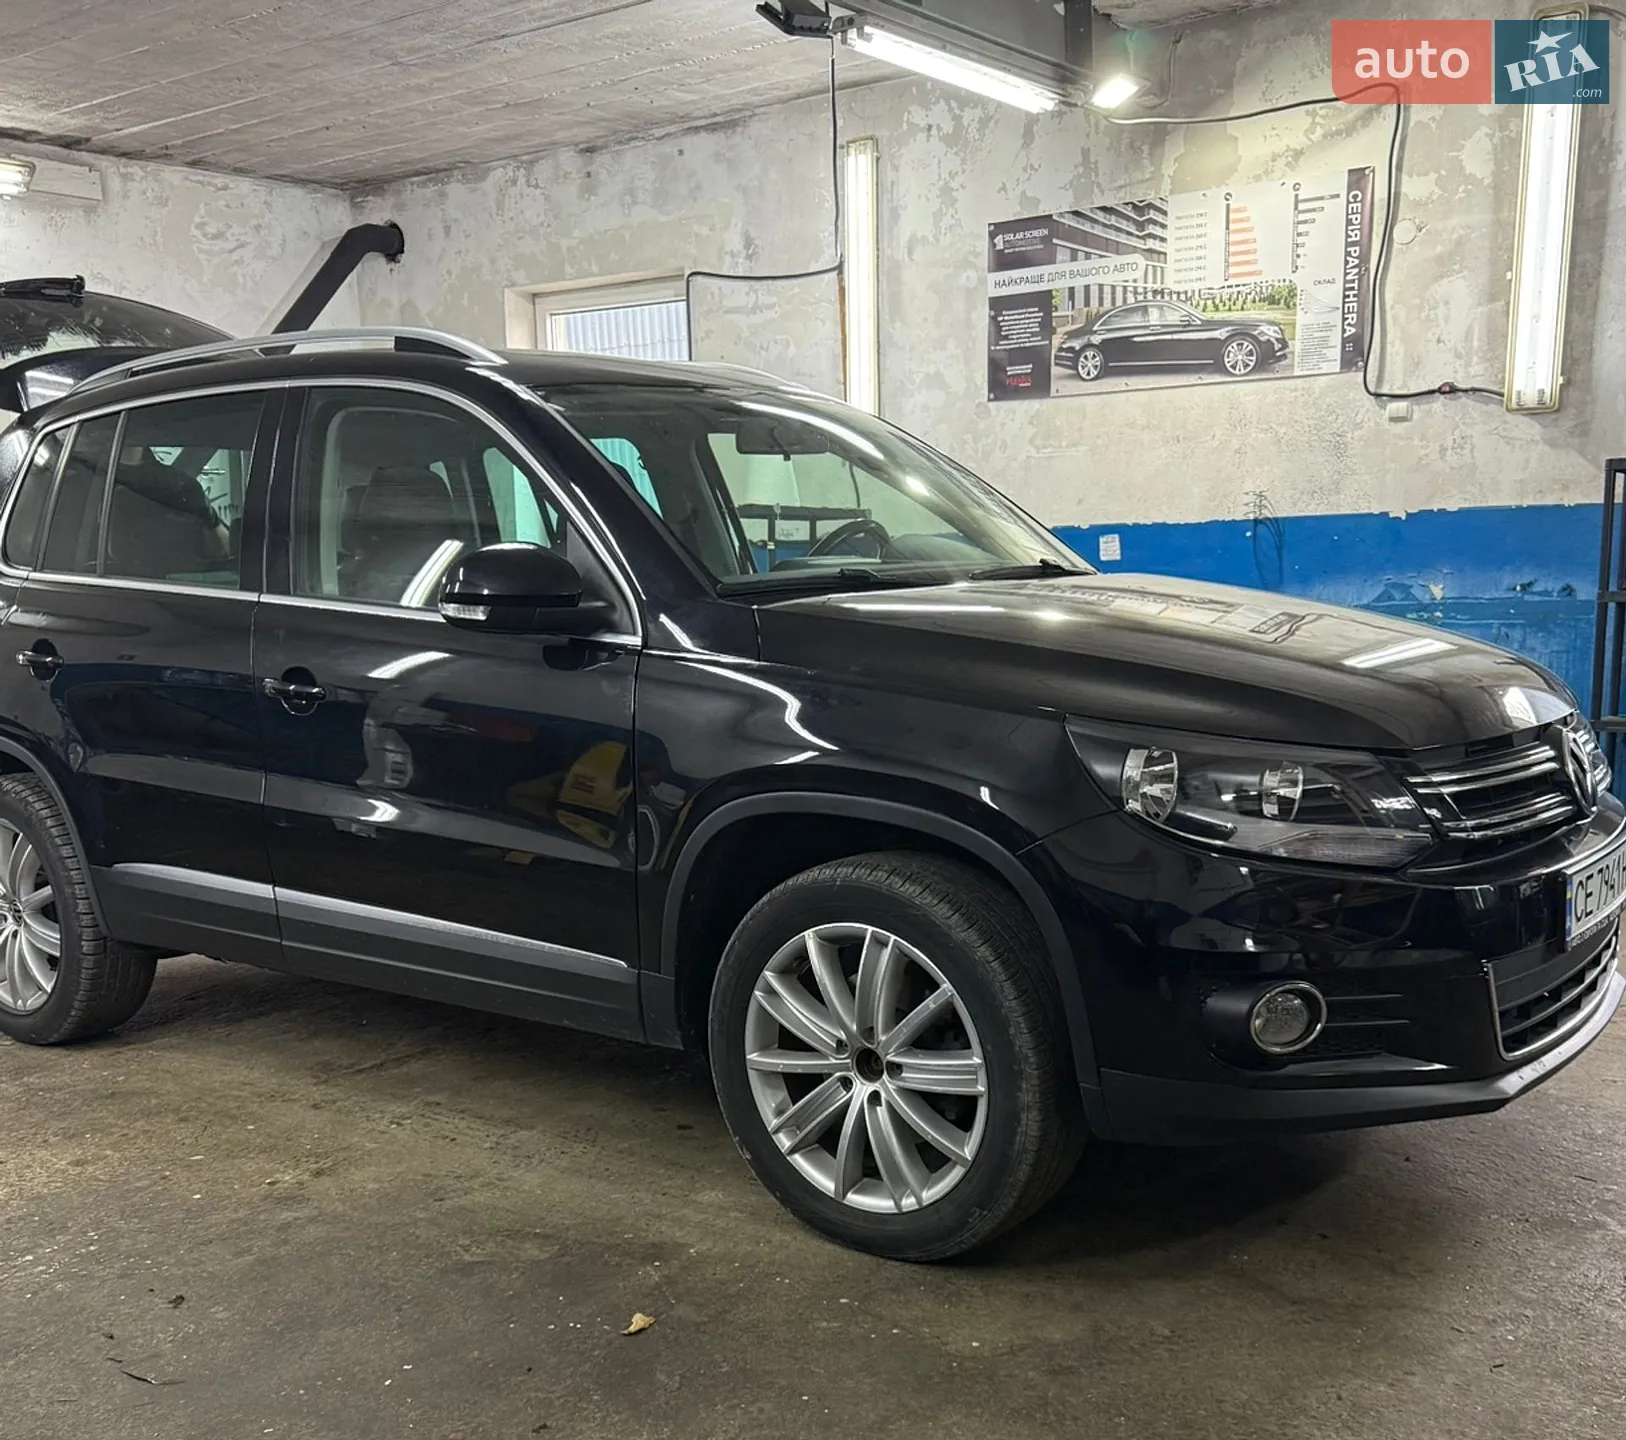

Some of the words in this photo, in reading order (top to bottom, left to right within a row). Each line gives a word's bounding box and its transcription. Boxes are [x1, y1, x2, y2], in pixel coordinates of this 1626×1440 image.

[1004, 232, 1024, 241] SOLAR
[1024, 228, 1049, 239] SCREEN
[1347, 190, 1362, 241] СЕРІЯ
[994, 273, 1045, 289] НАЙКРАЩЕ
[1047, 272, 1067, 283] ДЛЯ
[1069, 265, 1110, 280] ВАШОГО
[1112, 262, 1139, 274] АВТО
[1343, 246, 1360, 338] PANTHERA
